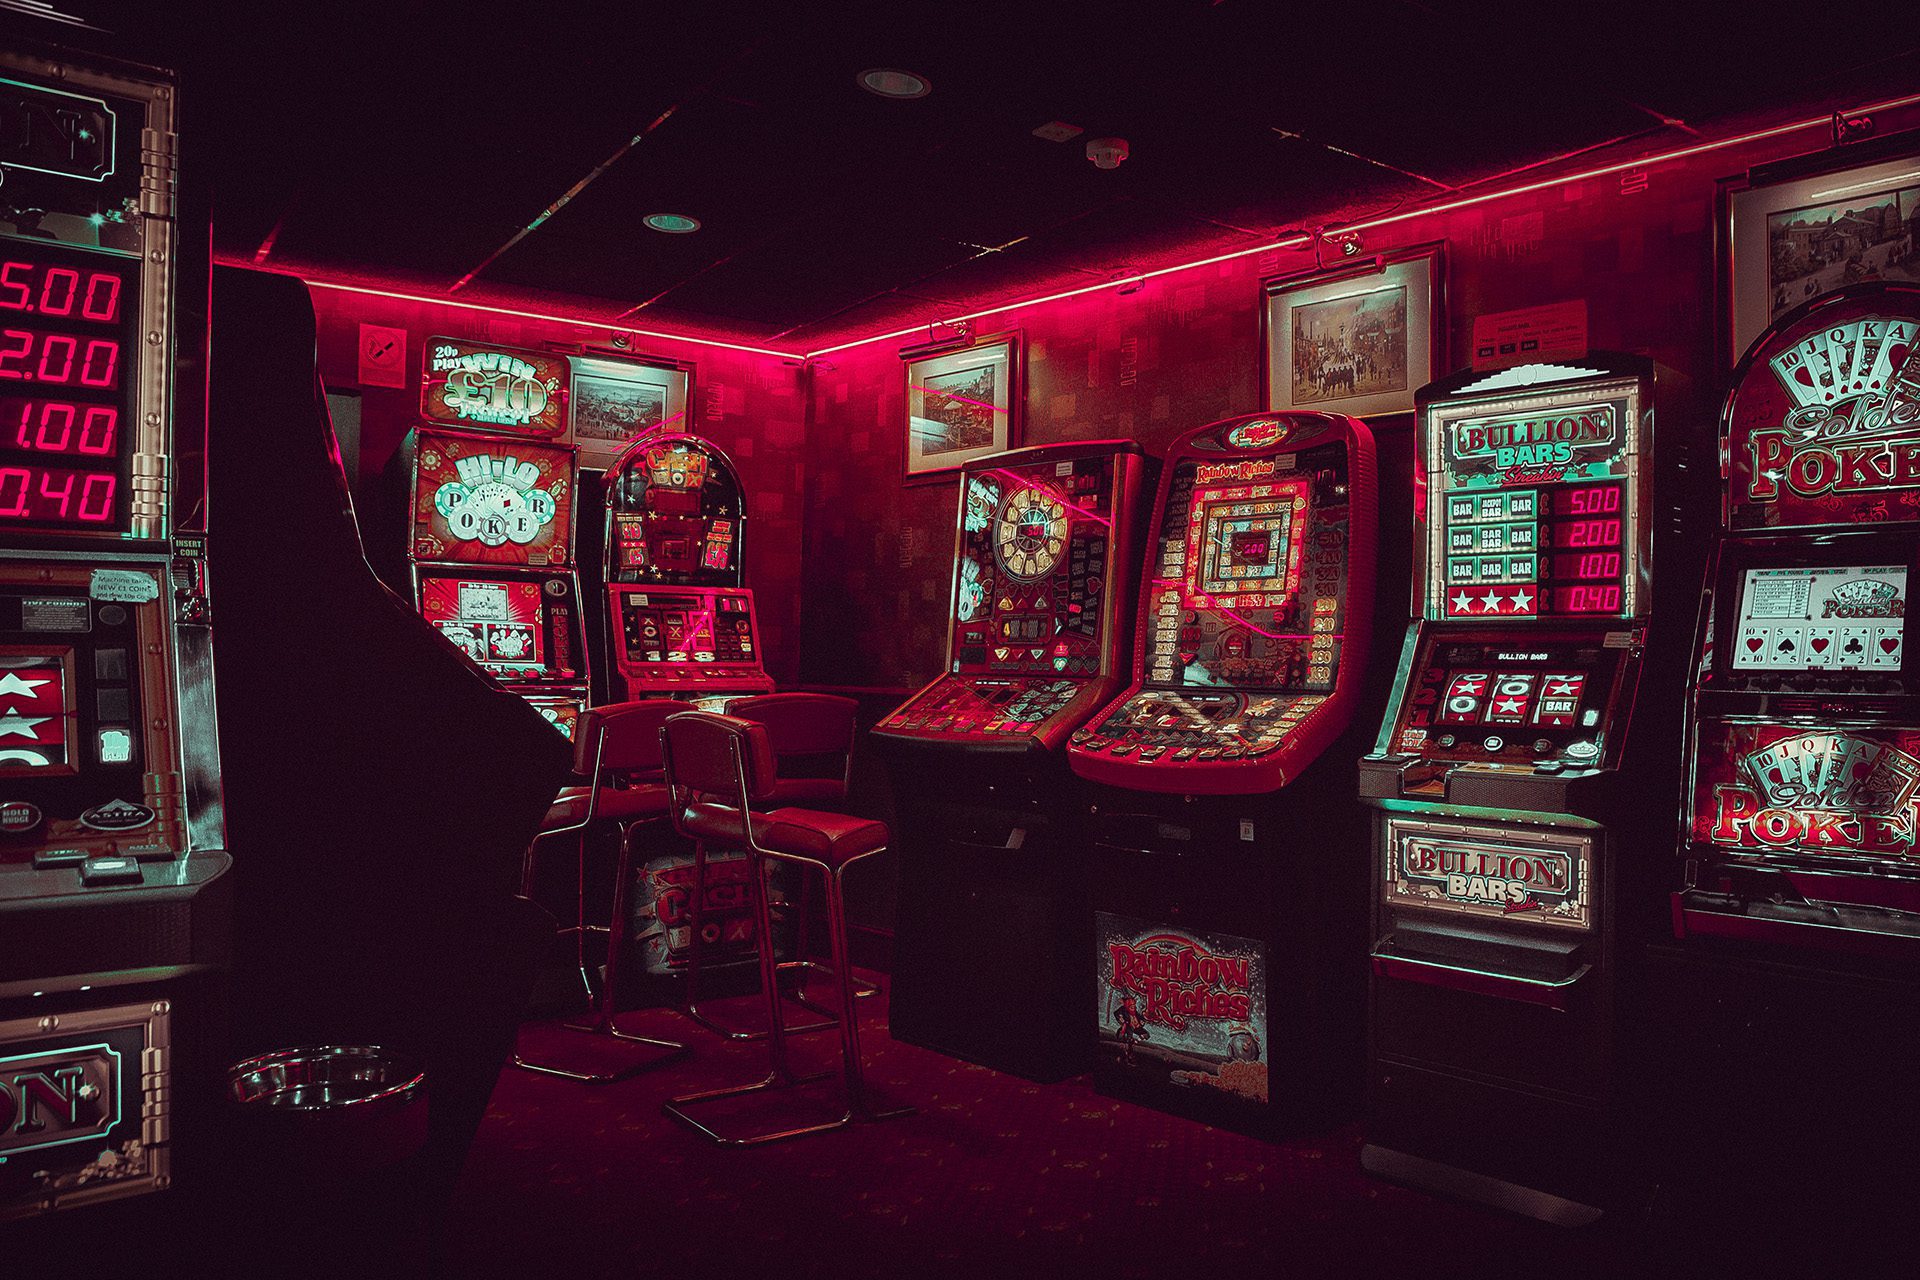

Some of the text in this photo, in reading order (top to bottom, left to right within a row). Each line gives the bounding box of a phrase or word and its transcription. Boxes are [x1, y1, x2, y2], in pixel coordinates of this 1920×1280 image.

[0, 262, 121, 321] 5.00
[0, 330, 119, 387] 2.00
[434, 345, 459, 359] 20p
[1778, 322, 1906, 371] 10 J Q K A
[461, 353, 537, 380] WIN
[443, 368, 548, 417] £10
[17, 402, 118, 454] 1.00
[1466, 413, 1603, 450] BULLION
[1497, 441, 1573, 468] BARS
[1195, 463, 1239, 484] Rainbow
[1238, 461, 1275, 480] Riches
[0, 468, 116, 521] 0.40
[1453, 503, 1473, 517] BAR
[1511, 498, 1532, 512] BAR
[1481, 507, 1502, 518] BAR
[175, 539, 202, 548] INSERT
[1453, 533, 1473, 547] BAR
[1481, 529, 1502, 539] BAR
[1511, 530, 1532, 544] BAR
[1569, 518, 1621, 548] 2.00
[1481, 539, 1502, 549] BAR
[179, 548, 199, 557] COIN
[98, 576, 130, 584] Machine
[1453, 564, 1473, 577] BAR
[1481, 563, 1502, 576] BAR
[1511, 561, 1532, 575] BAR
[97, 584, 116, 592] NEW
[1569, 585, 1621, 612] 0.40
[1745, 628, 1886, 636] 10 5 2 2 9
[1498, 653, 1549, 661] BULLION BARS
[1752, 655, 1763, 663] 10
[1789, 655, 1797, 664] 5
[1823, 655, 1830, 664] 2
[1857, 655, 1865, 664] 2
[1544, 700, 1573, 712] BAR
[1755, 754, 1773, 770] 10
[1779, 745, 1790, 759] J
[1801, 739, 1814, 751] Q
[1831, 738, 1845, 752] K
[1852, 744, 1868, 760] A
[1767, 776, 1896, 810] Golden
[2, 809, 30, 817] HOLD
[2, 816, 30, 825] NUDGE
[89, 811, 146, 819] ASTRA
[1418, 847, 1557, 886] BULLION
[1448, 874, 1527, 903] BARS
[1107, 941, 1250, 996] Rainbow
[1139, 976, 1250, 1031] Riches
